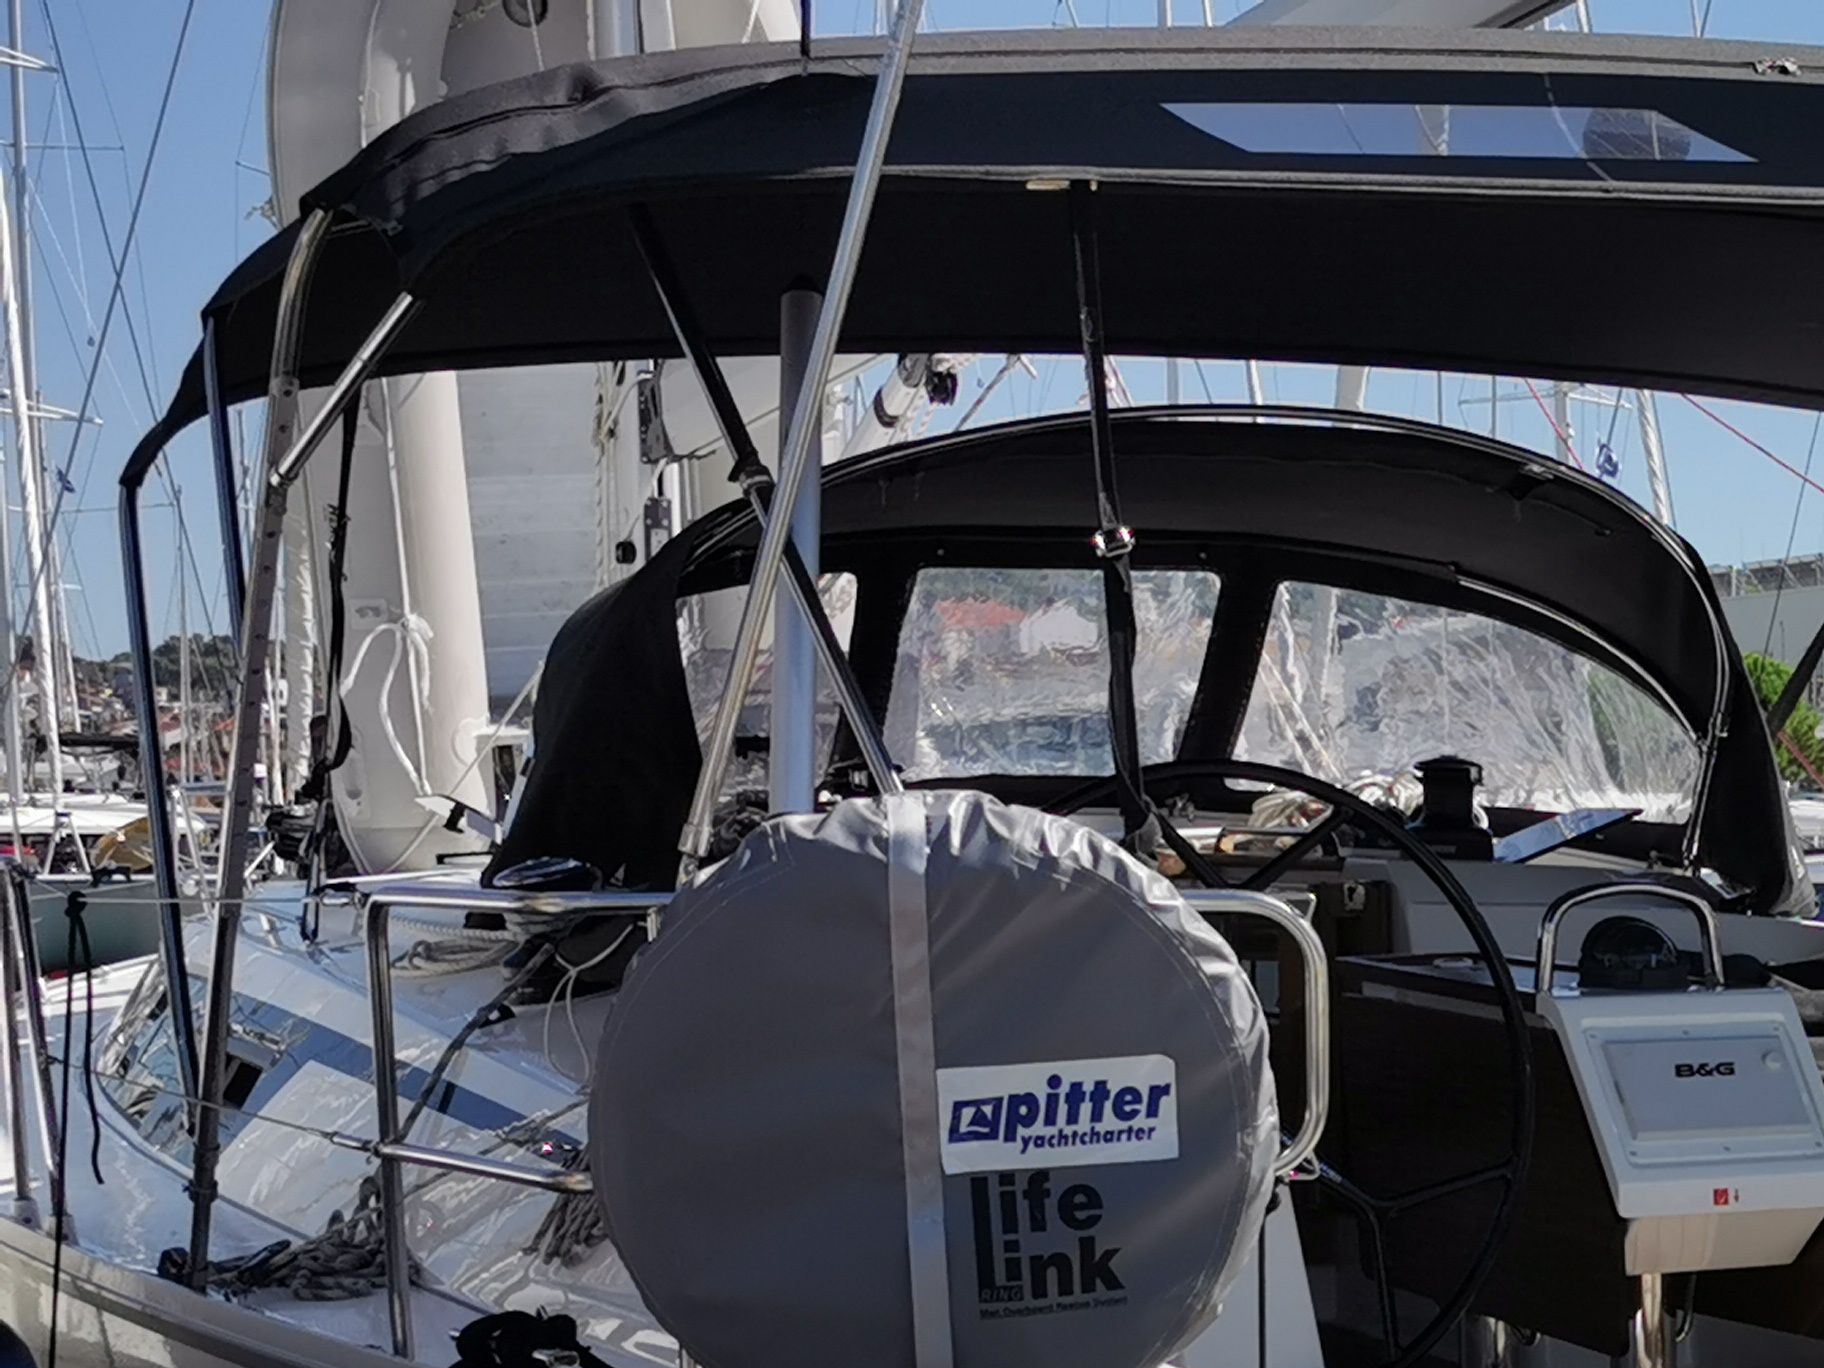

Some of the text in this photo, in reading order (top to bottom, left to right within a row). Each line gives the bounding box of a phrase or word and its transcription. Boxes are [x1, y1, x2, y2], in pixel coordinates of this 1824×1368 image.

[1675, 1062, 1735, 1078] B&G
[1003, 1074, 1171, 1143] pitter
[1020, 1124, 1155, 1155] yachtcharter
[981, 1286, 1022, 1302] RING
